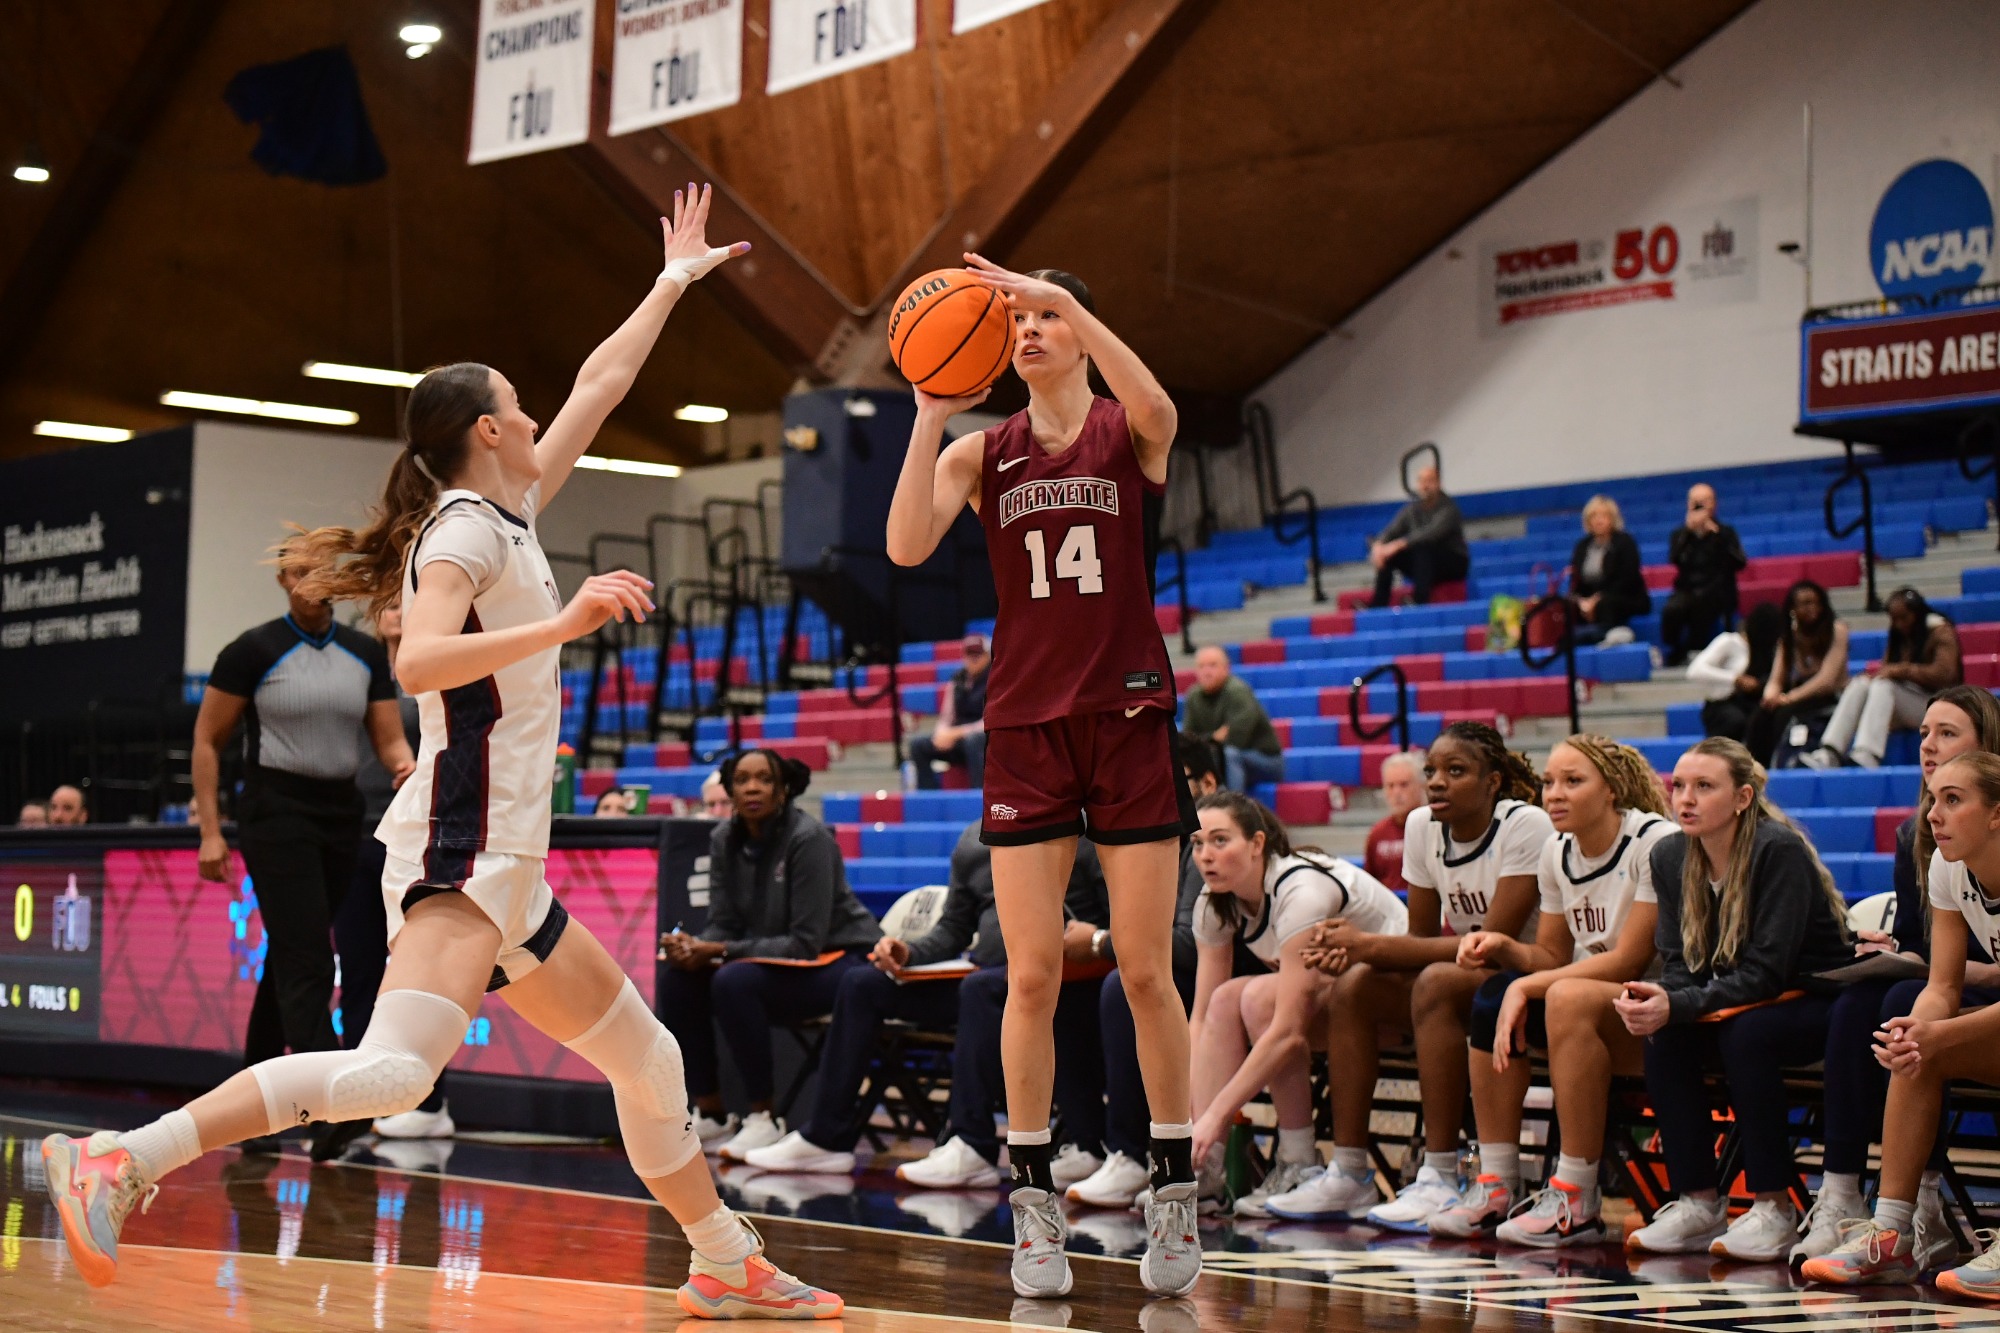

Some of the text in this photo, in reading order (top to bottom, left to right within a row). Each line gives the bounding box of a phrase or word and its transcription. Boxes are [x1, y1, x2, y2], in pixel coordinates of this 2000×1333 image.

[485, 7, 582, 61] CHAMPIONS
[815, 0, 867, 64] FDU
[650, 49, 700, 111] FDU
[506, 86, 554, 142] FDU
[1612, 223, 1679, 280] 50
[1882, 225, 1990, 284] NCAA
[1820, 331, 2000, 388] STRATIS ARE
[1002, 480, 1116, 525] LAFAYETTE
[1024, 525, 1103, 598] 14
[1151, 676, 1158, 684] M
[14, 884, 34, 941] 0
[1448, 891, 1487, 915] FDU
[1573, 907, 1606, 933] FDU
[29, 985, 67, 1011] FOULS
[69, 987, 80, 1012] 0
